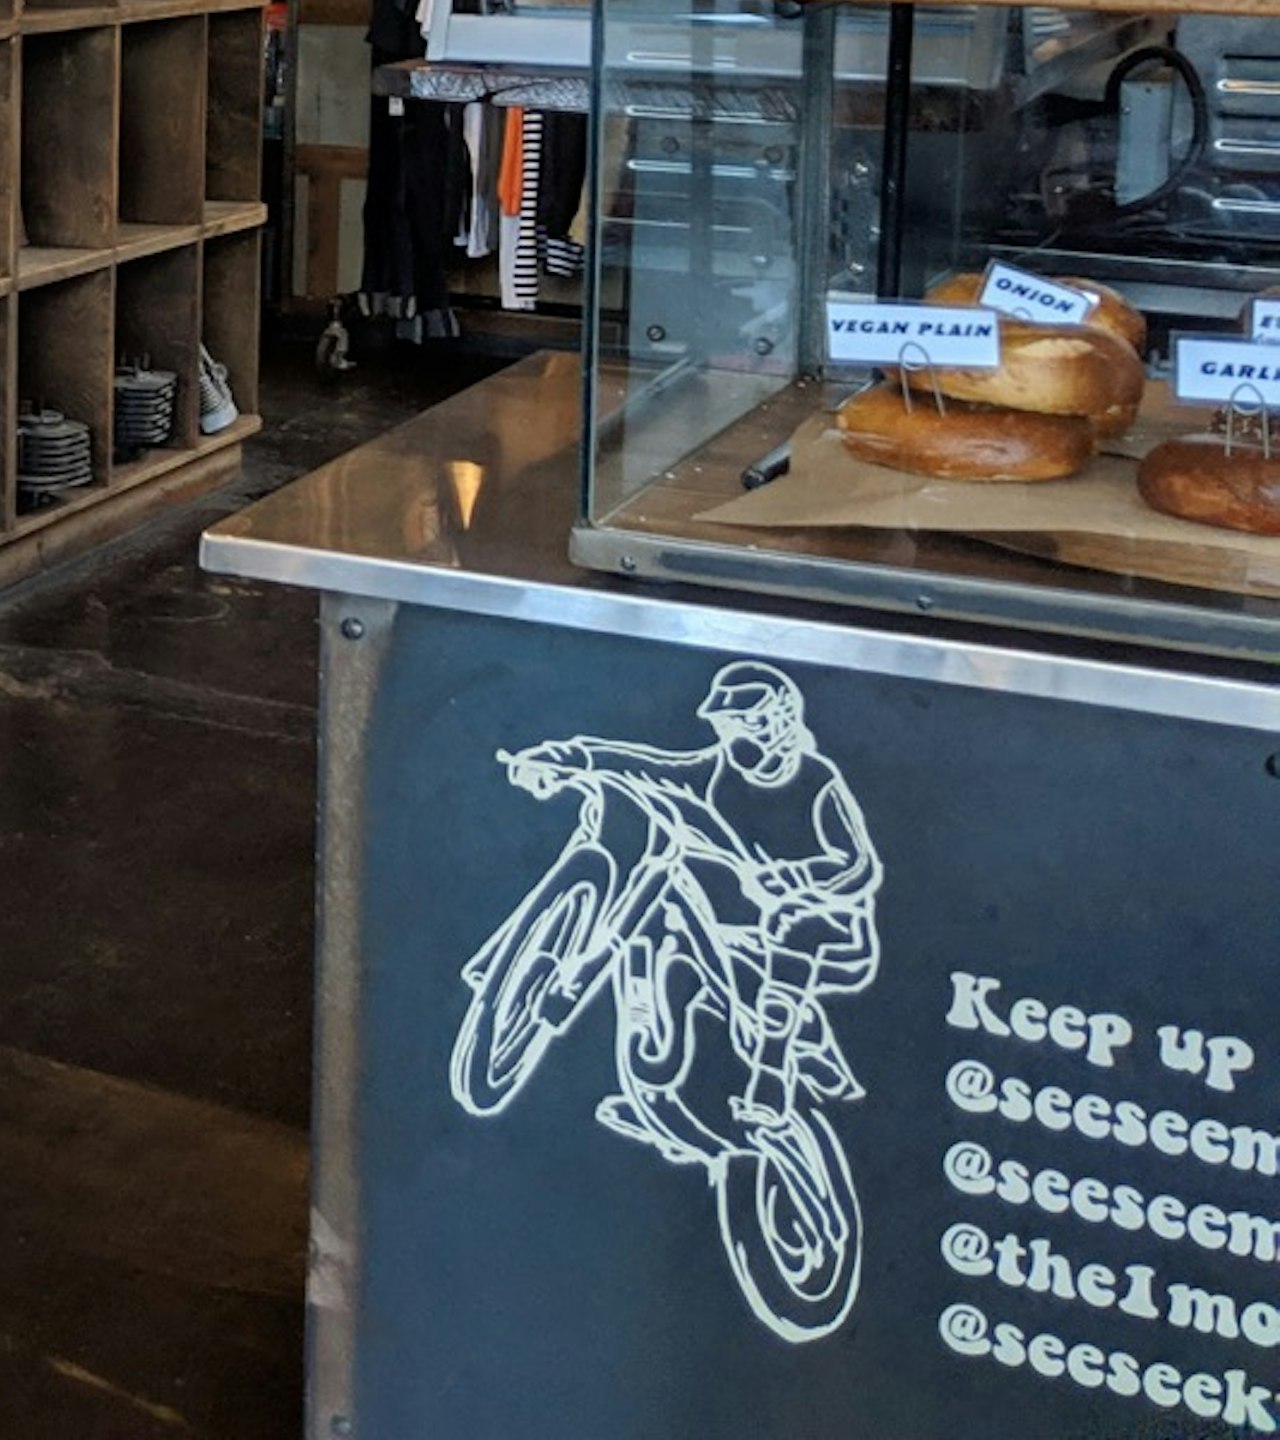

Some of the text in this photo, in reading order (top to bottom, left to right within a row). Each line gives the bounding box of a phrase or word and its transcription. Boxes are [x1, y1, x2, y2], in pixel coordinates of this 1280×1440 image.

[831, 319, 992, 338] VEGAN PLAIN
[995, 275, 1076, 315] ONION
[945, 970, 1256, 1093] Keep up
[938, 1303, 1280, 1433] @seeseek
